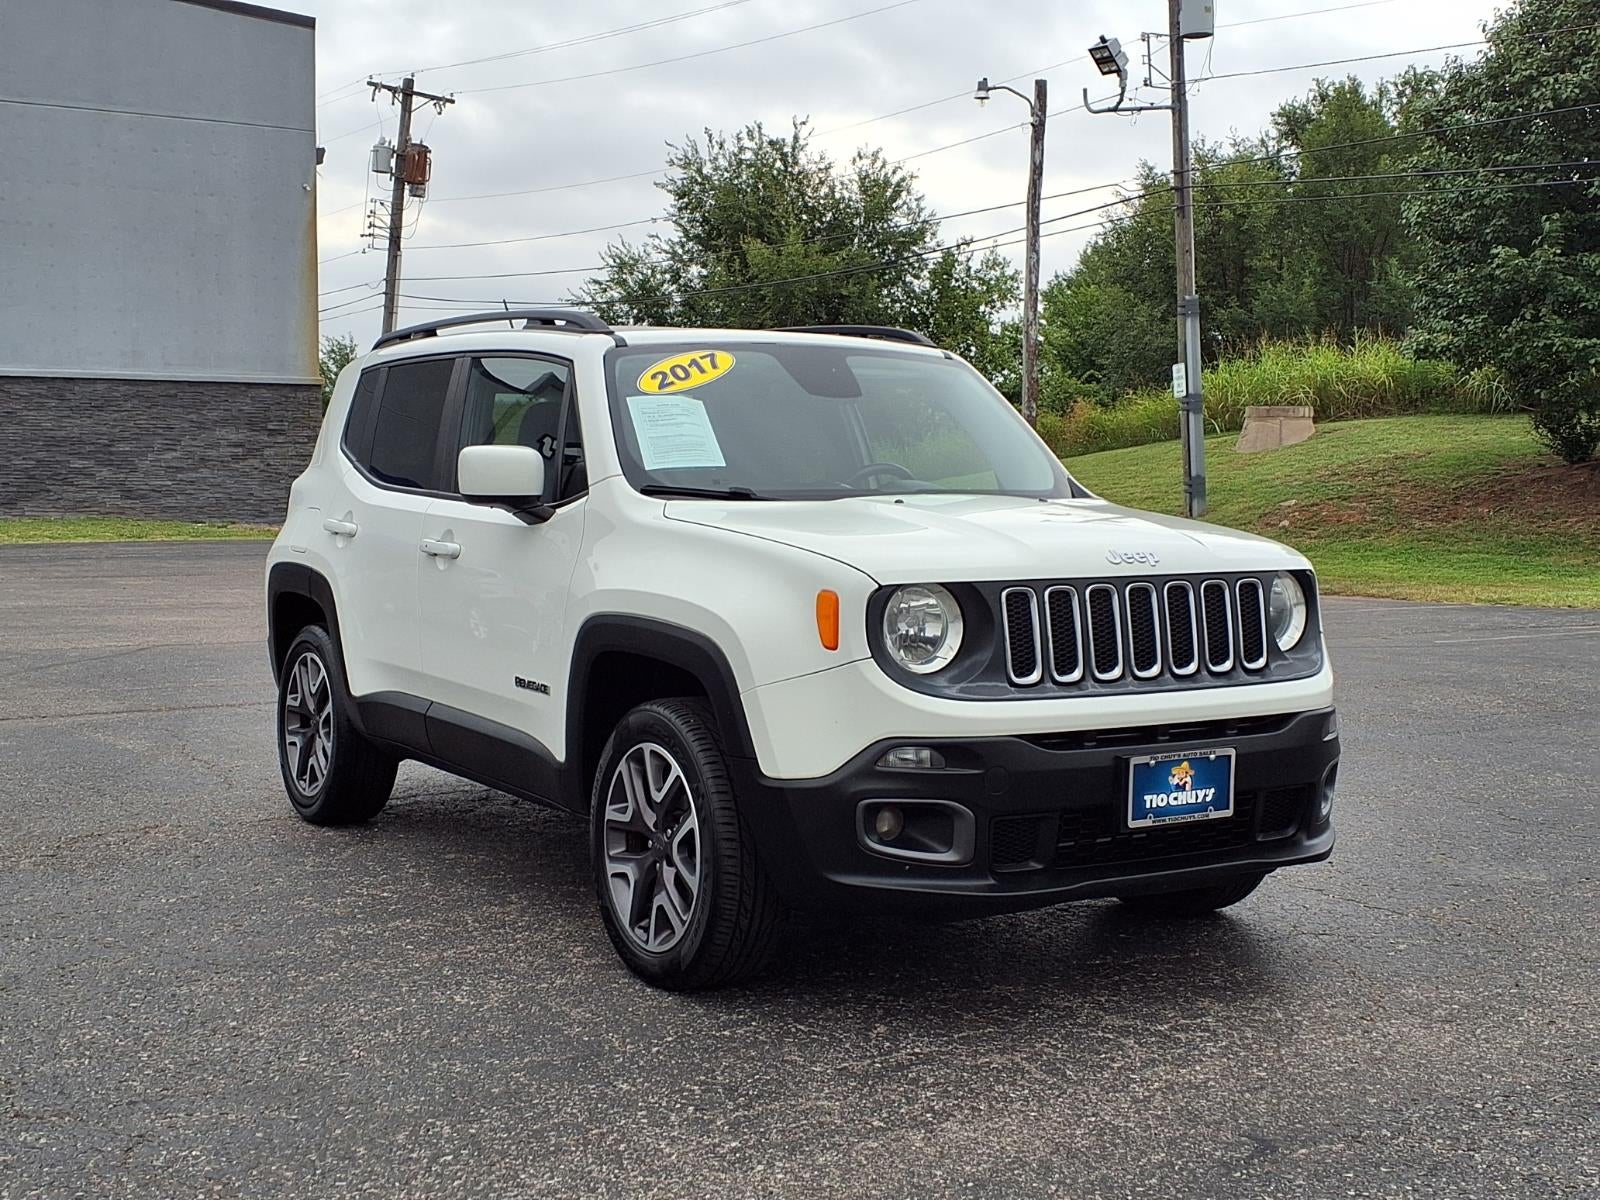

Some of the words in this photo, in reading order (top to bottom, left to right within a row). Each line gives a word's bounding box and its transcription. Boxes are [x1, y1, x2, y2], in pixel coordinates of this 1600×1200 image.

[651, 353, 718, 390] 2017
[1105, 550, 1160, 567] Jeep
[1152, 813, 1210, 825] WWW.TIOCHUYS.COM
